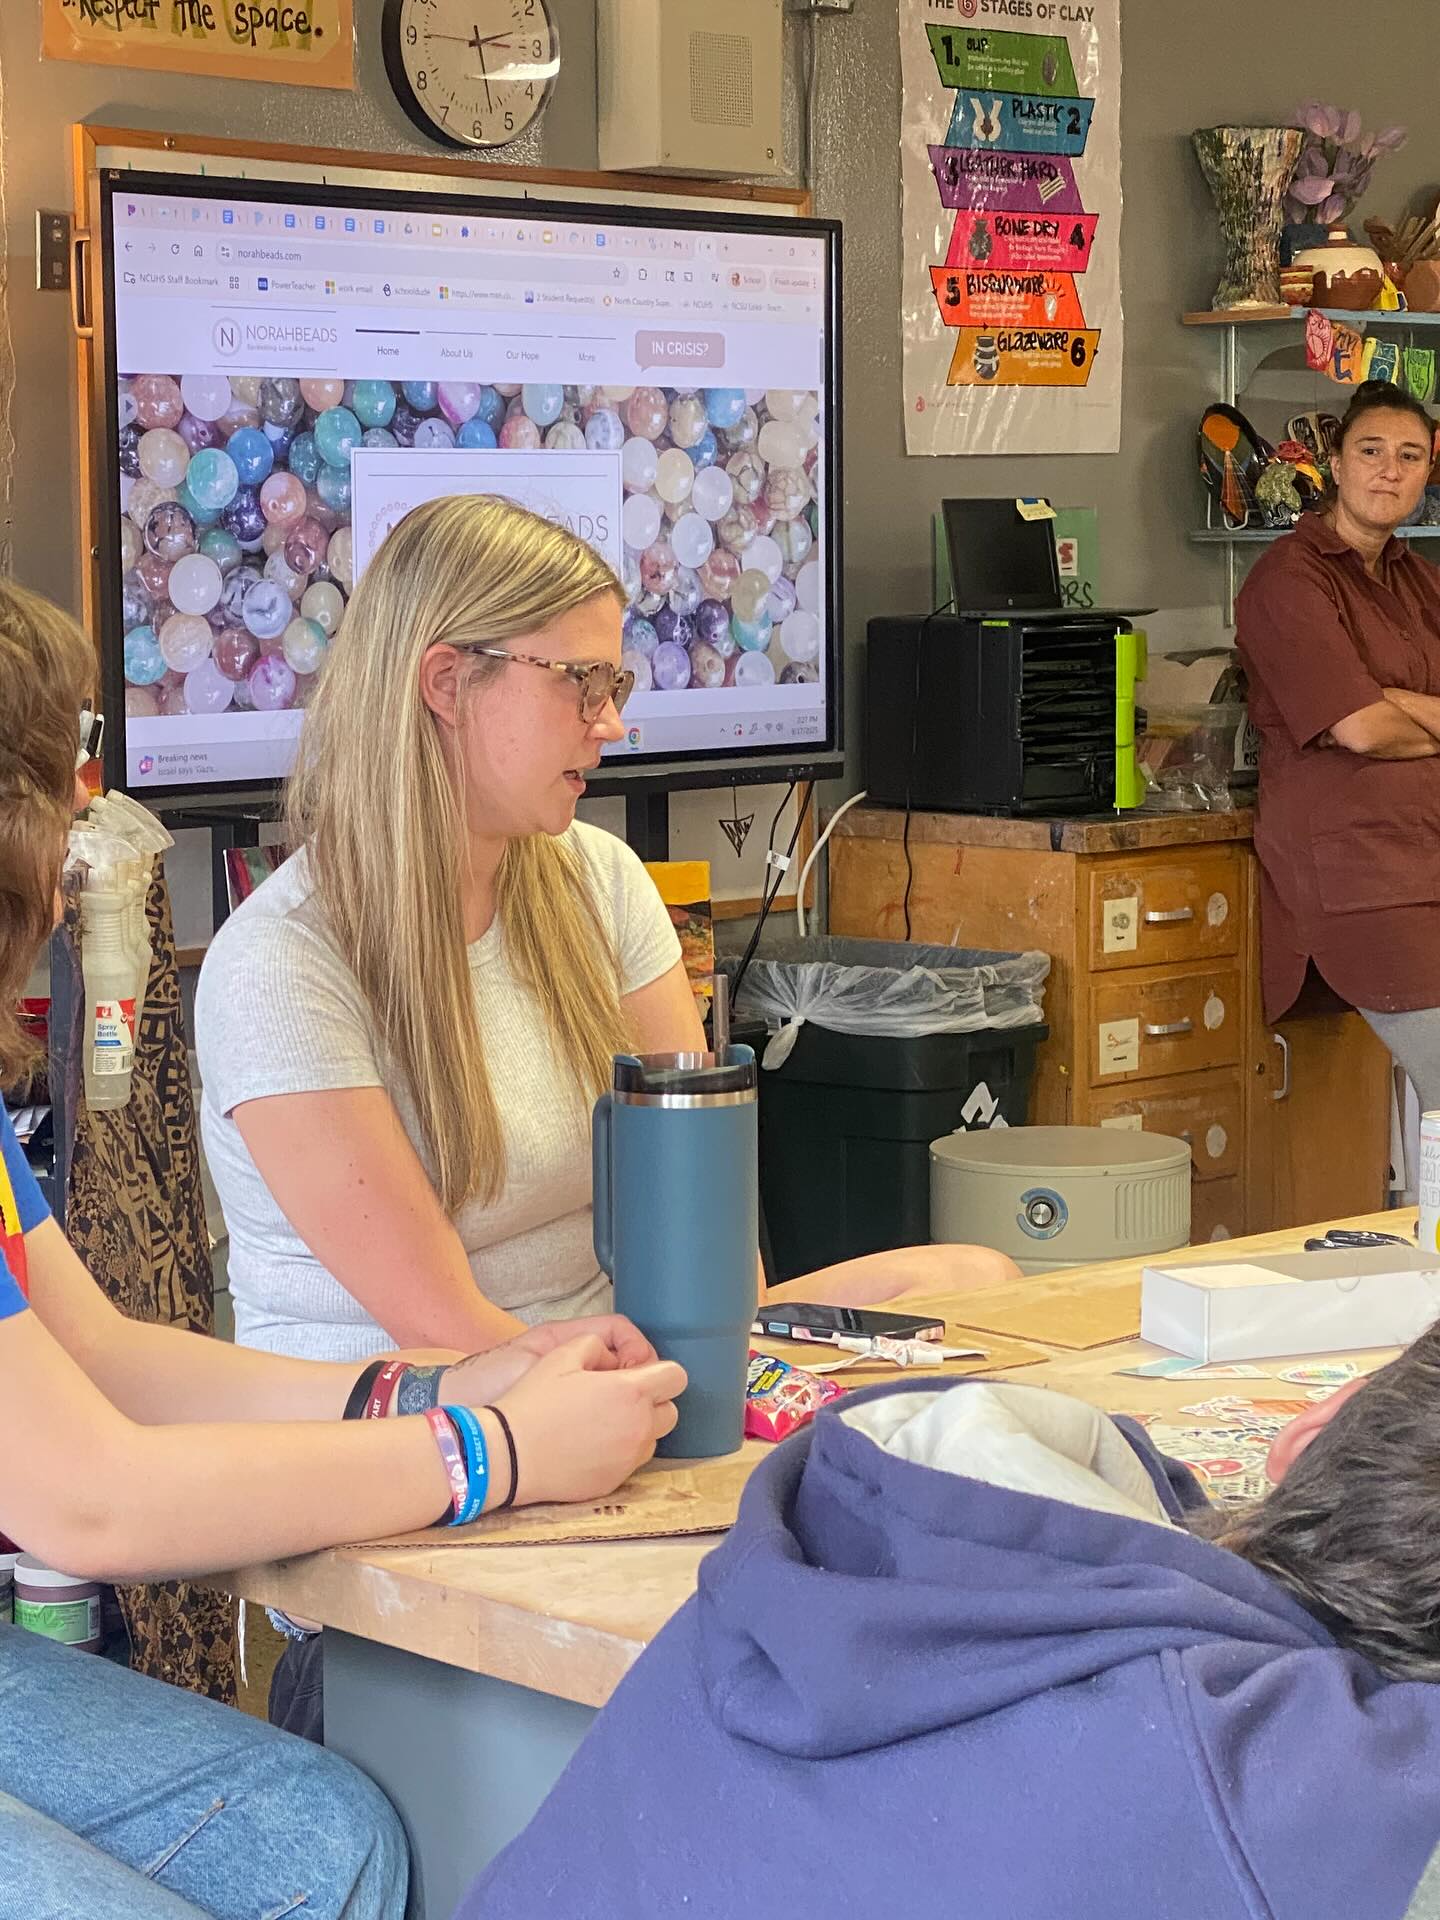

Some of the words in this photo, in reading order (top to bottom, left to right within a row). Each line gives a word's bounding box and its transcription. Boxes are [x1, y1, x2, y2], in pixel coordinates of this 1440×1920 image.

[928, 0, 955, 9] THE
[981, 0, 1033, 18] STAGES
[1036, 3, 1056, 20] OF
[1060, 5, 1096, 22] CLAY
[235, 2, 323, 47] space.
[406, 25, 417, 45] 9
[532, 40, 543, 58] 3
[417, 70, 427, 91] 8
[525, 83, 534, 100] 4
[439, 106, 449, 125] 7
[504, 112, 514, 131] 5
[1067, 106, 1081, 135] 2
[472, 120, 482, 139] 6
[995, 216, 1031, 236] BONE
[1033, 219, 1060, 239] DRY
[238, 247, 302, 261] norahbeads.com
[185, 275, 218, 286] Bookmark
[271, 280, 317, 291] PowerTeacher
[945, 276, 960, 307] 5
[220, 326, 235, 348] N
[246, 325, 339, 343] NORAHBEADS
[377, 346, 400, 357] Home
[440, 348, 461, 358] About
[463, 349, 473, 358] Us
[506, 351, 519, 360] Our
[521, 351, 539, 361] Hope
[578, 352, 596, 362] More
[651, 342, 664, 355] IN
[668, 342, 710, 357] CRISIS?
[1070, 337, 1086, 368] 6
[158, 754, 188, 764] Breaking
[97, 1023, 117, 1031] Spray
